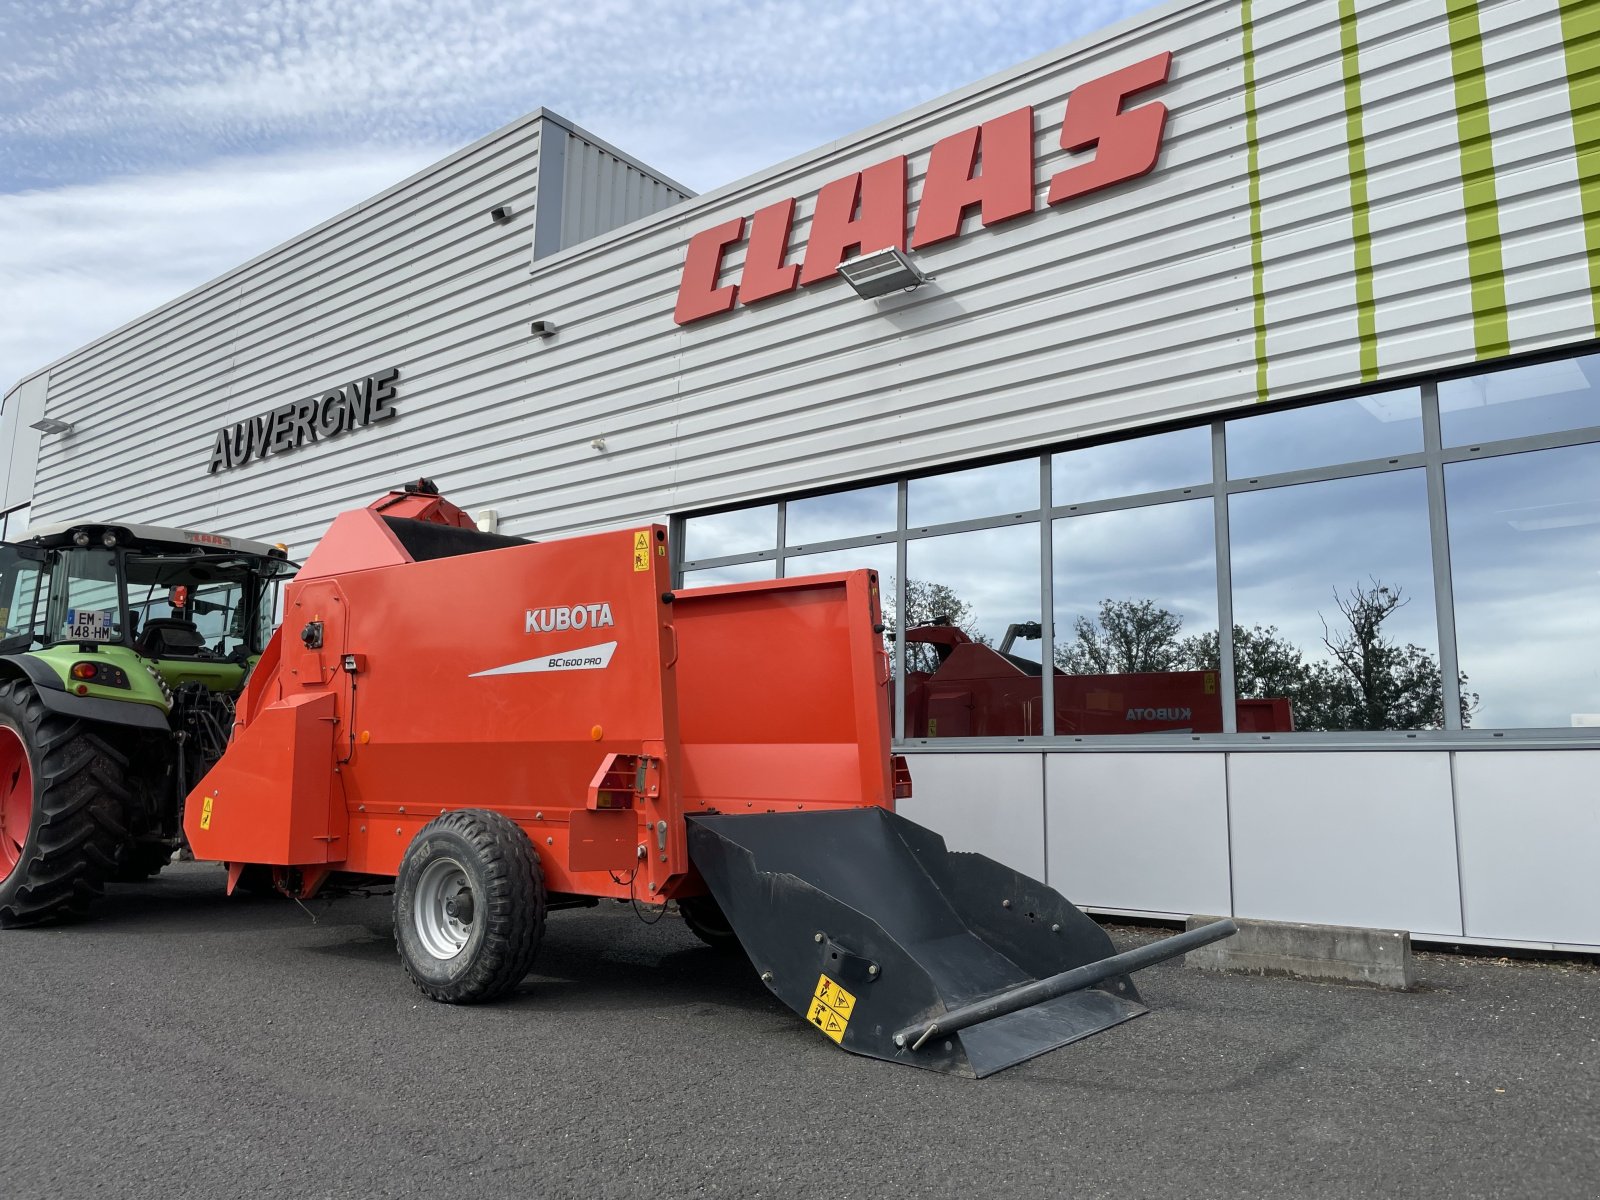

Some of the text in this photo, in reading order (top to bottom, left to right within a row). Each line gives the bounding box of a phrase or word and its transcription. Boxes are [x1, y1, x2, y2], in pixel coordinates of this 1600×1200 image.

[673, 51, 1173, 326] CLAAS
[207, 367, 399, 474] AUVERGNE
[79, 612, 95, 625] EM
[525, 602, 615, 633] KUBOTA
[548, 657, 602, 668] BC1600 PRO
